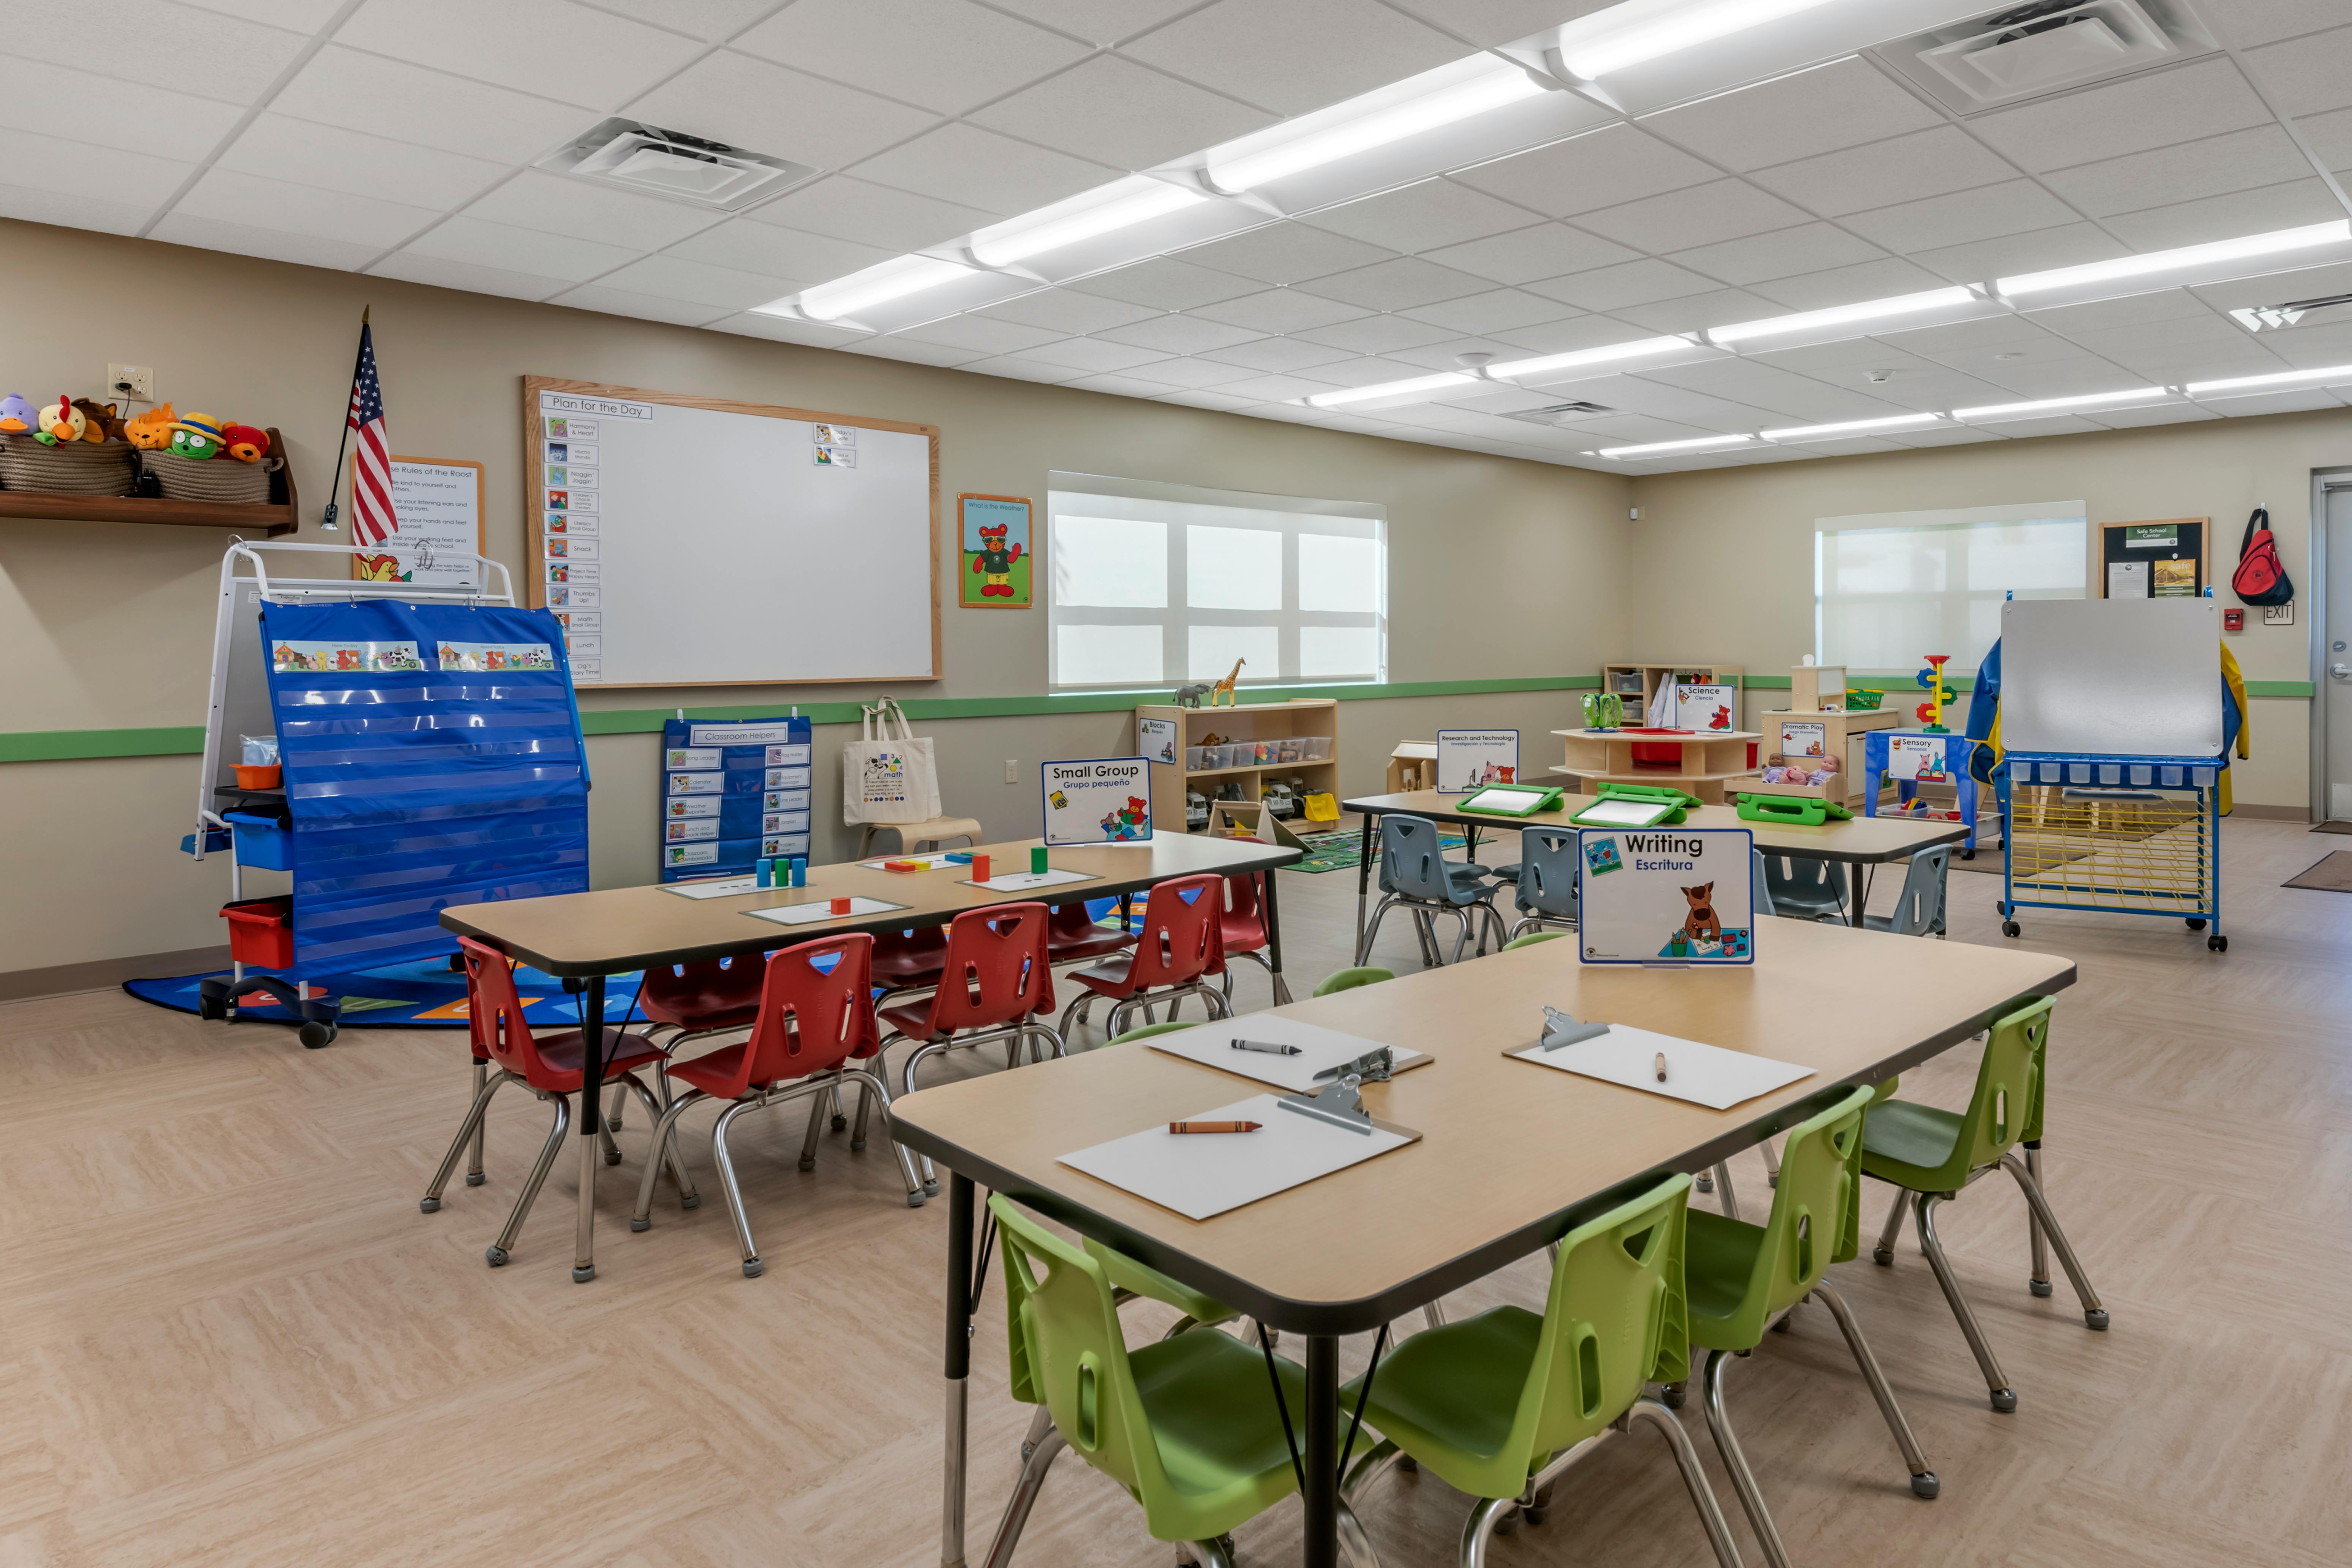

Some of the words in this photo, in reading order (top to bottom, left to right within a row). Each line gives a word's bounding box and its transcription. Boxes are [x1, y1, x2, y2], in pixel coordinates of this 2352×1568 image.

[553, 397, 577, 408] Plan
[581, 400, 596, 410] for
[599, 403, 617, 413] the
[621, 405, 642, 417] Day
[2171, 561, 2191, 570] safe
[2266, 605, 2291, 618] EXIT
[705, 732, 748, 741] Classroom
[749, 732, 776, 740] Helpers
[1902, 738, 1932, 748] Sensory
[1053, 766, 1091, 779] Small
[1095, 765, 1139, 778] Group
[1092, 779, 1130, 789] pequeño
[1625, 834, 1702, 858] Writing
[1636, 859, 1693, 871] Escritura
